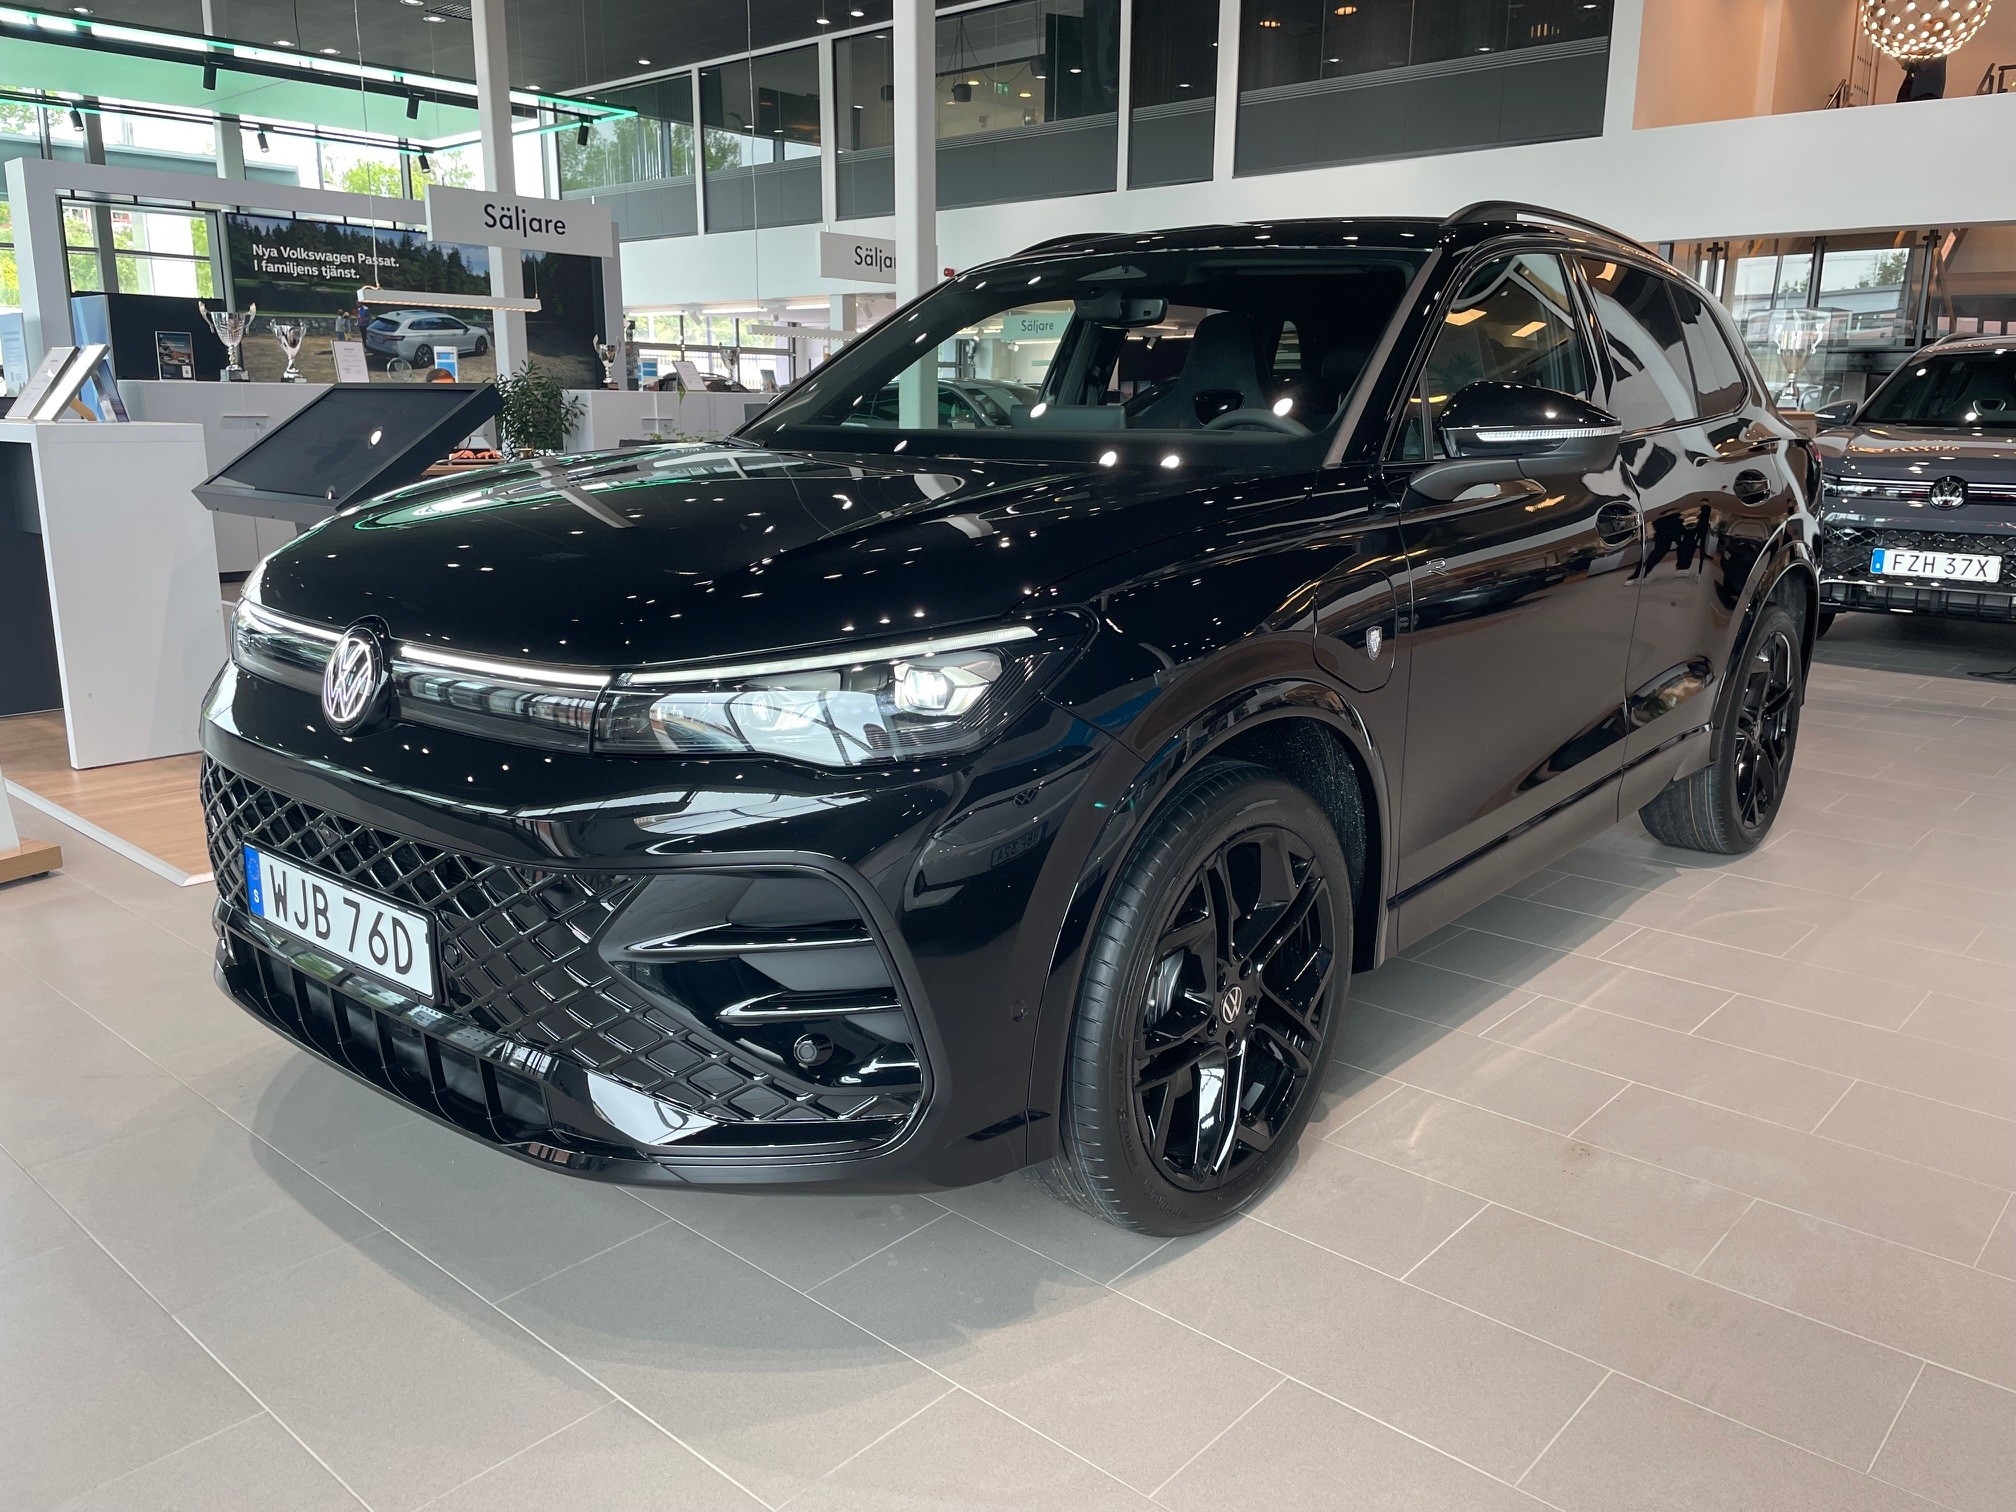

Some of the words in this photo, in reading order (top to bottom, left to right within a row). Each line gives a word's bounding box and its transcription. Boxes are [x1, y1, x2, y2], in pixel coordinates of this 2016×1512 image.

[484, 203, 566, 237] Säljare
[252, 244, 278, 259] Nya
[280, 246, 355, 264] Volkswagen
[358, 253, 400, 267] Passat.
[253, 260, 258, 271] I
[261, 260, 319, 277] familjens
[321, 265, 360, 279] tjänst.
[1021, 319, 1054, 334] Säljare
[1892, 554, 1936, 574] FZH
[1944, 557, 1989, 578] 37X
[253, 888, 260, 904] S
[269, 865, 331, 940] WJB
[342, 897, 413, 975] 76D
